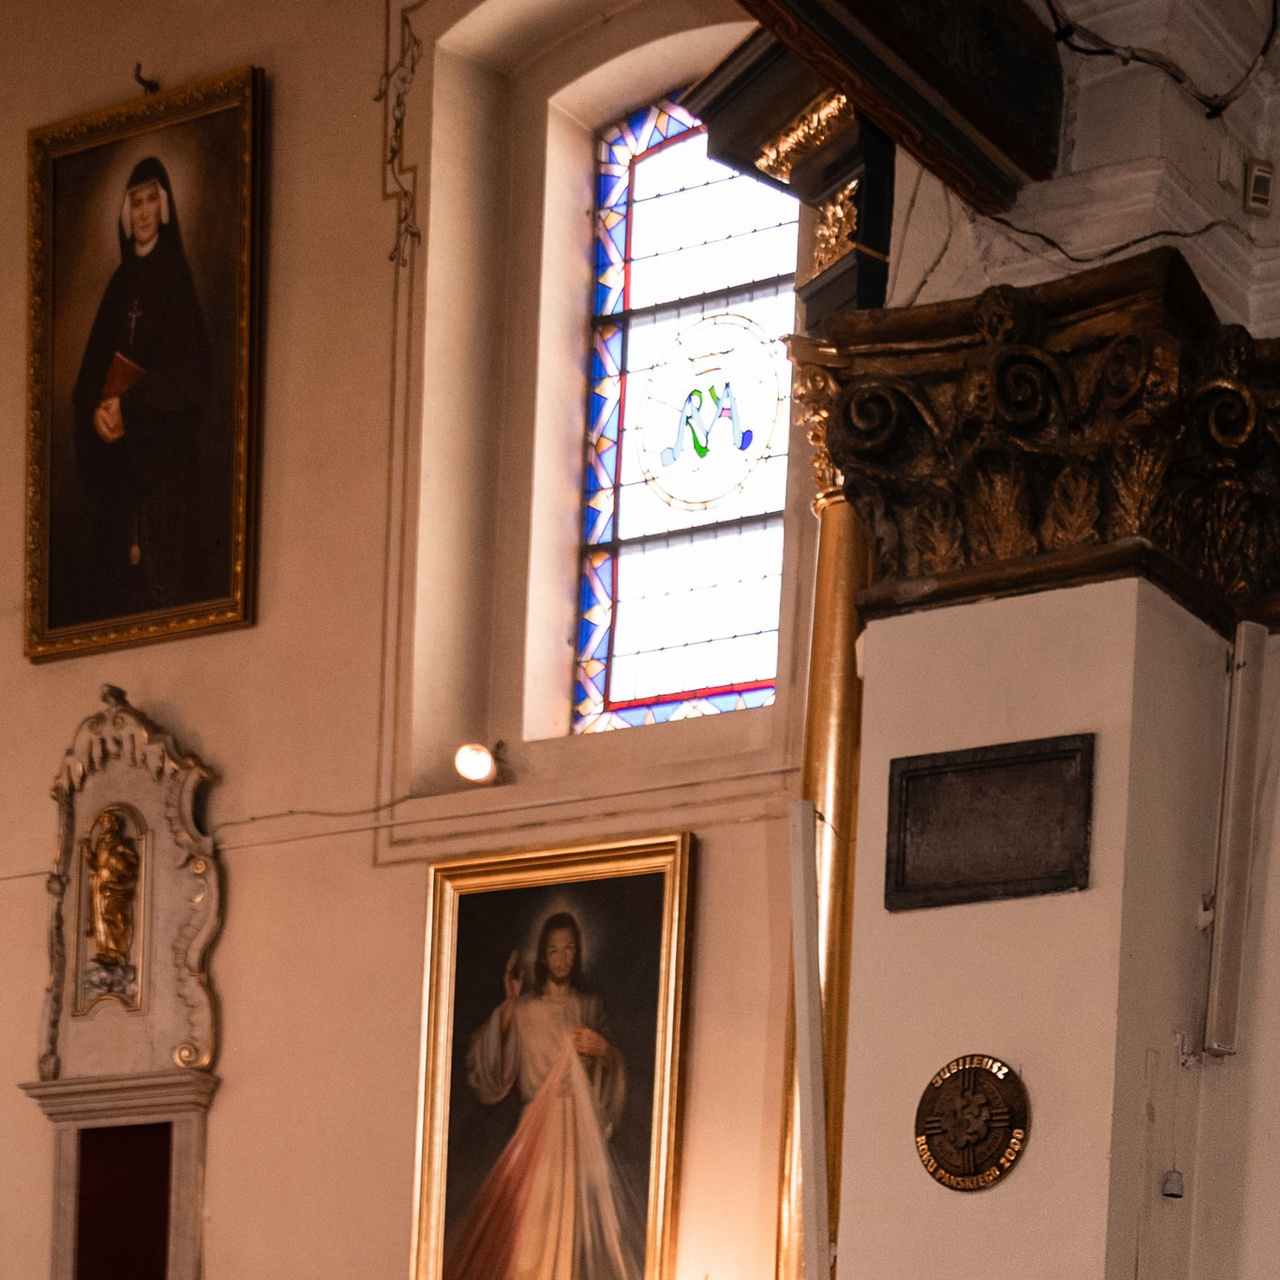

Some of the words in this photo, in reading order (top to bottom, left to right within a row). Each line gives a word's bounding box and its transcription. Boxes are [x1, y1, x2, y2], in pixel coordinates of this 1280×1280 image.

[932, 1056, 1009, 1087] JUBILEUSZ
[916, 1135, 937, 1173] ROKU
[999, 1128, 1025, 1169] 2000
